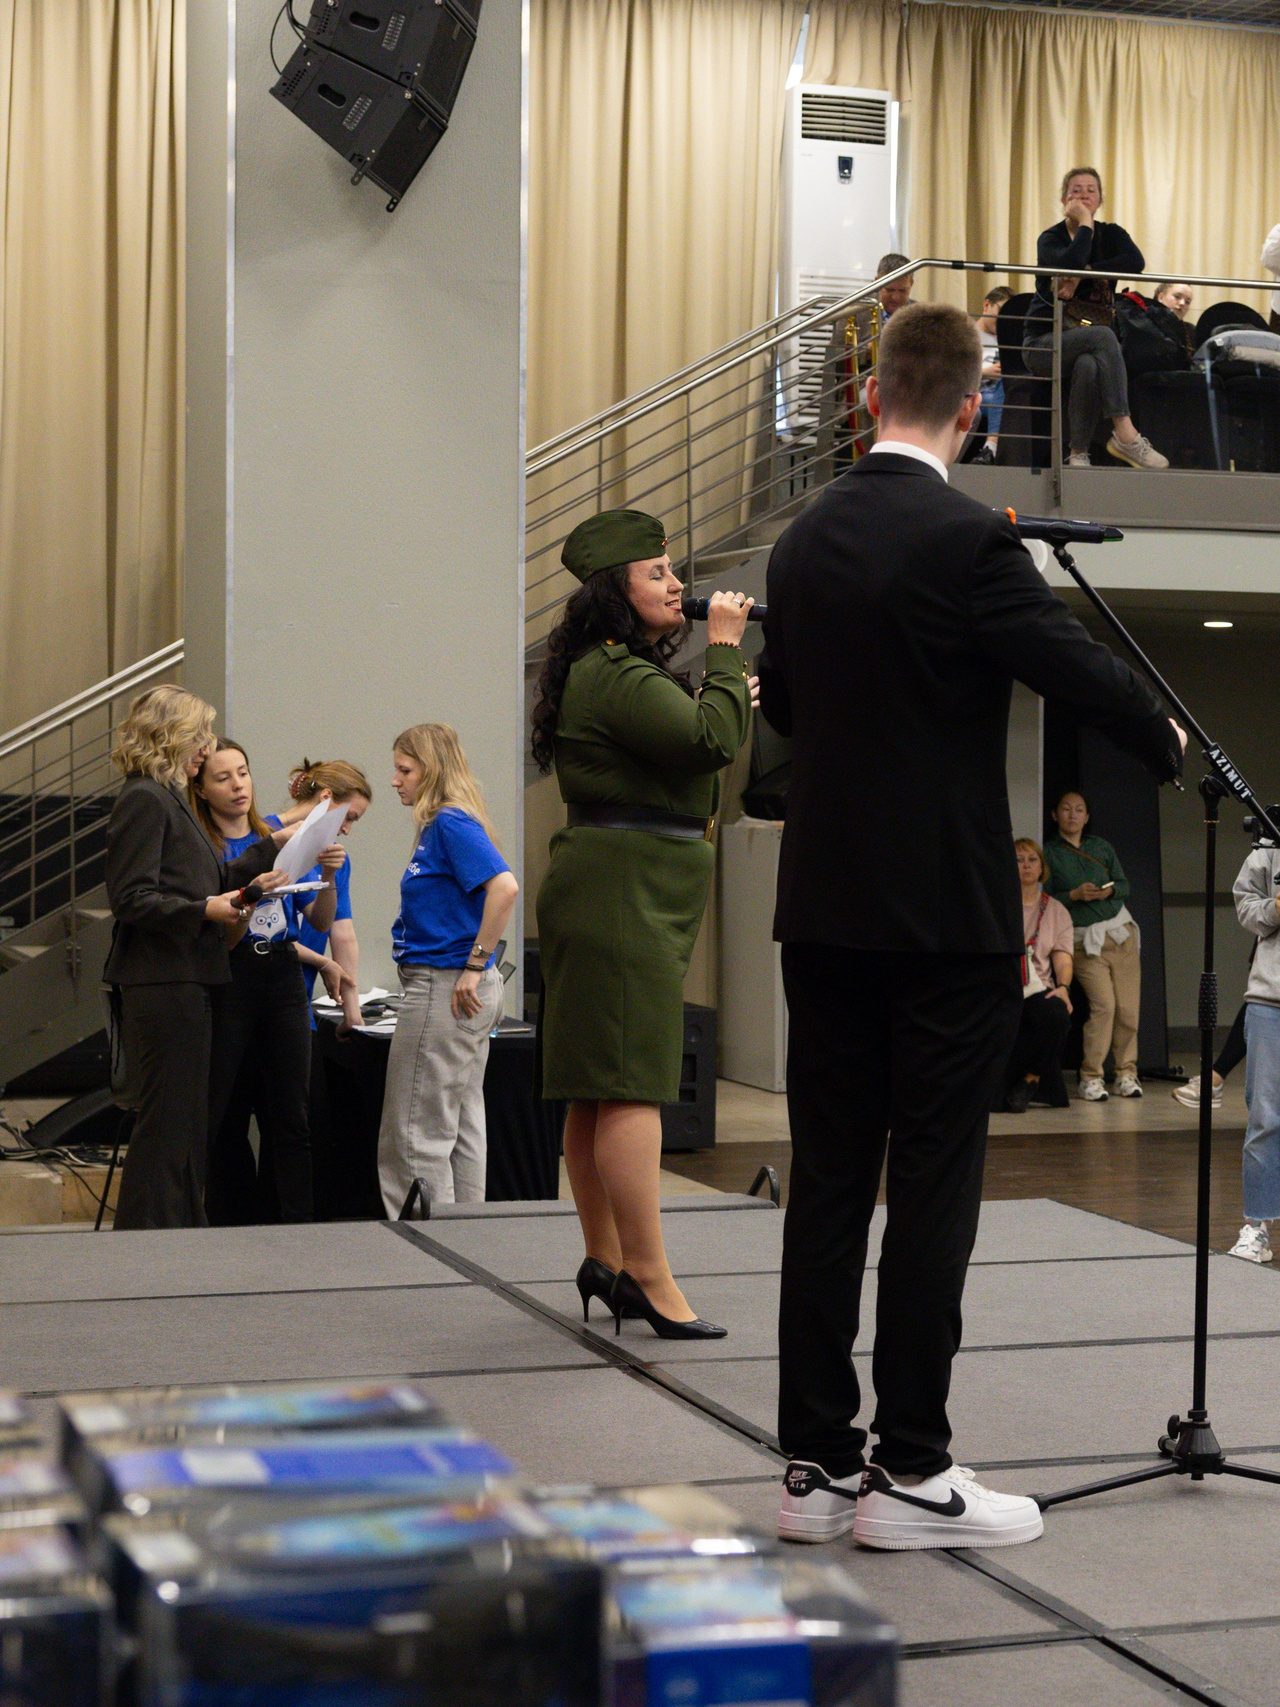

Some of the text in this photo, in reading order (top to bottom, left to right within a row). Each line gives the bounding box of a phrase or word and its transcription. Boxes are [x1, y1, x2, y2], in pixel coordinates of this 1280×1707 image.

[1209, 749, 1252, 799] AZIMUT
[408, 862, 421, 876] ебе
[791, 1469, 808, 1478] NIKE
[789, 1481, 806, 1489] AIR
